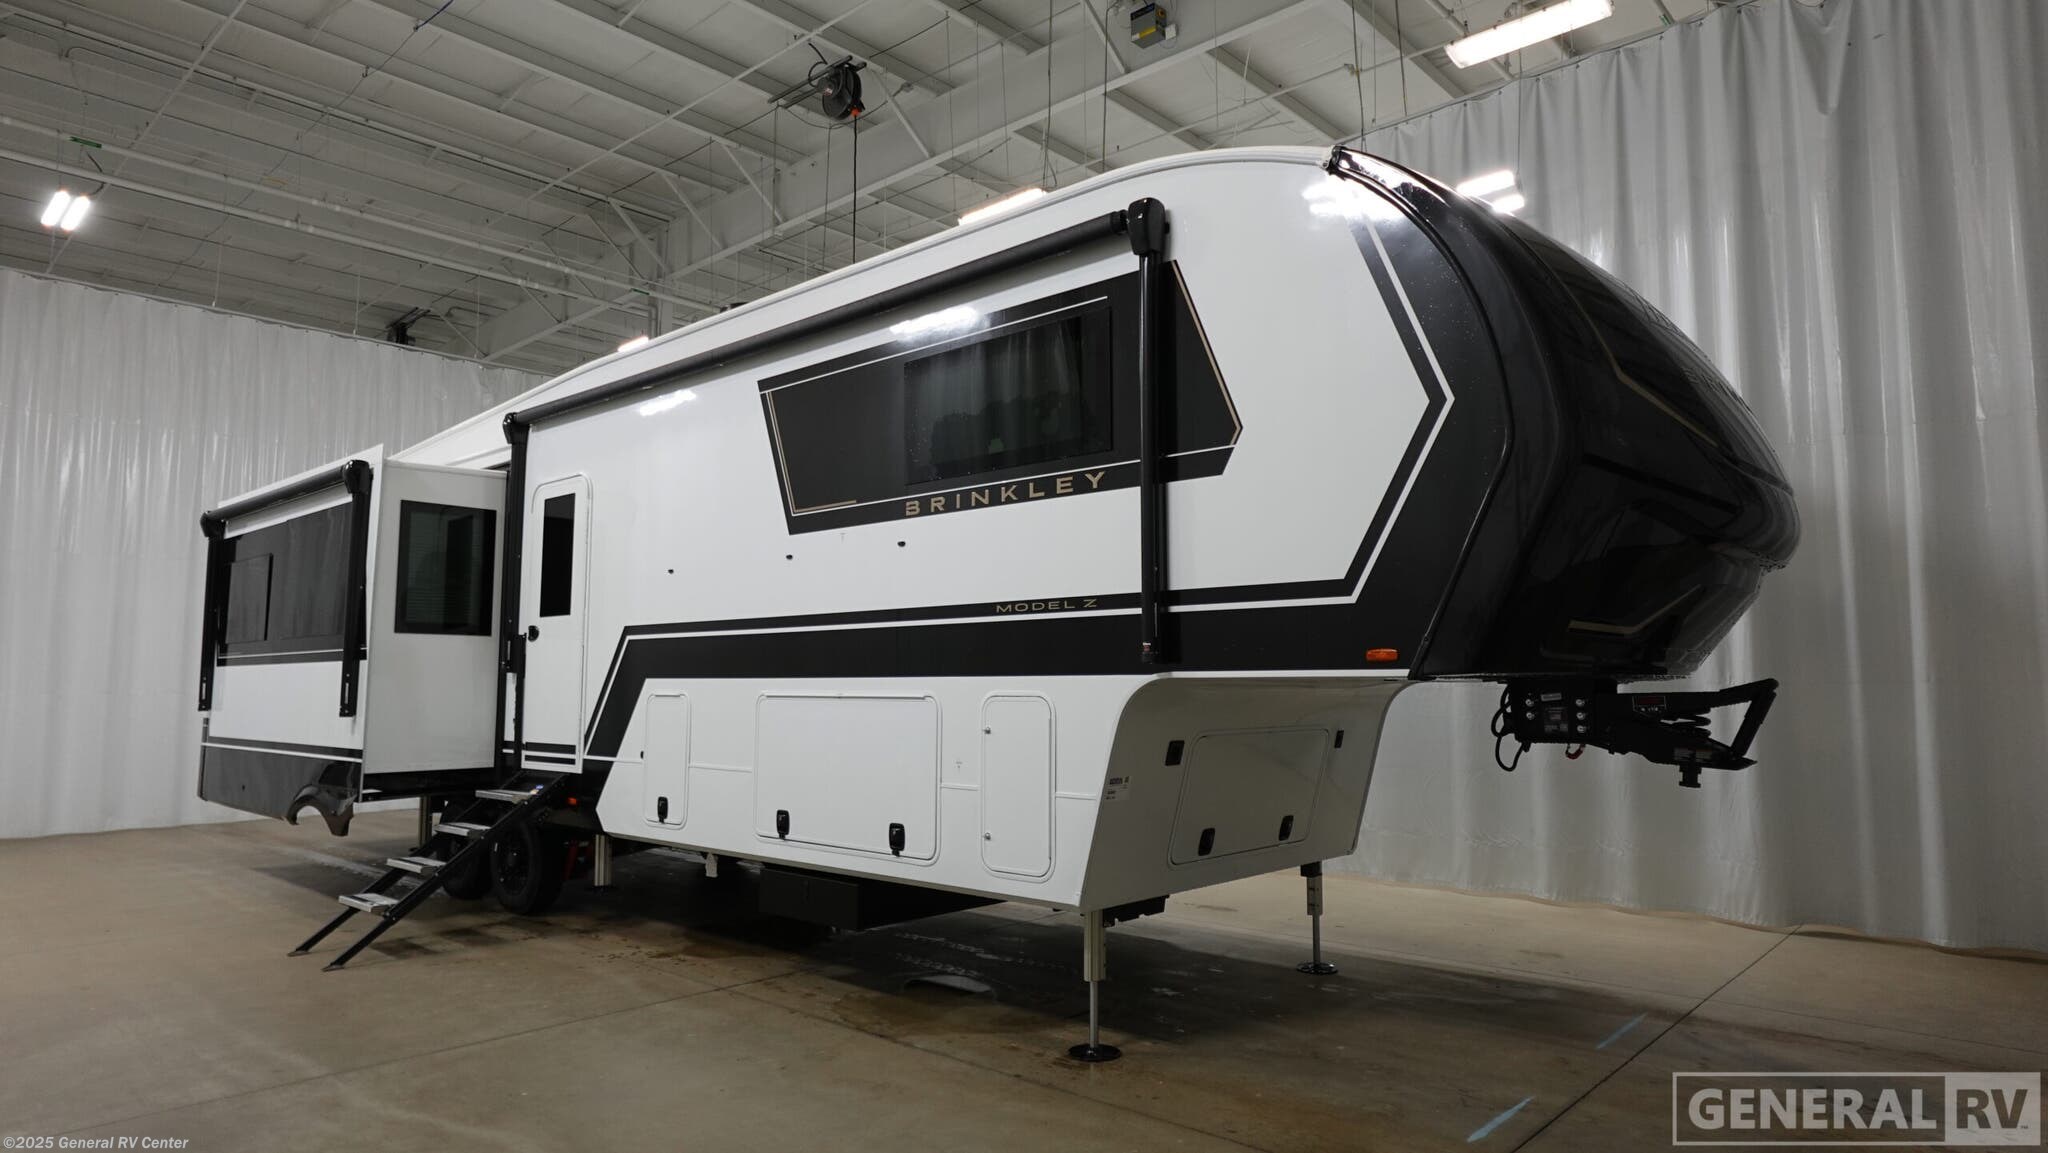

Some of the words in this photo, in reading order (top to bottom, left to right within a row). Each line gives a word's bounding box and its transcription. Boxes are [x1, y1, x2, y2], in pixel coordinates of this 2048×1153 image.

[905, 471, 1105, 517] BRINKLEY
[996, 600, 1075, 613] MODEL
[1083, 598, 1097, 608] Z
